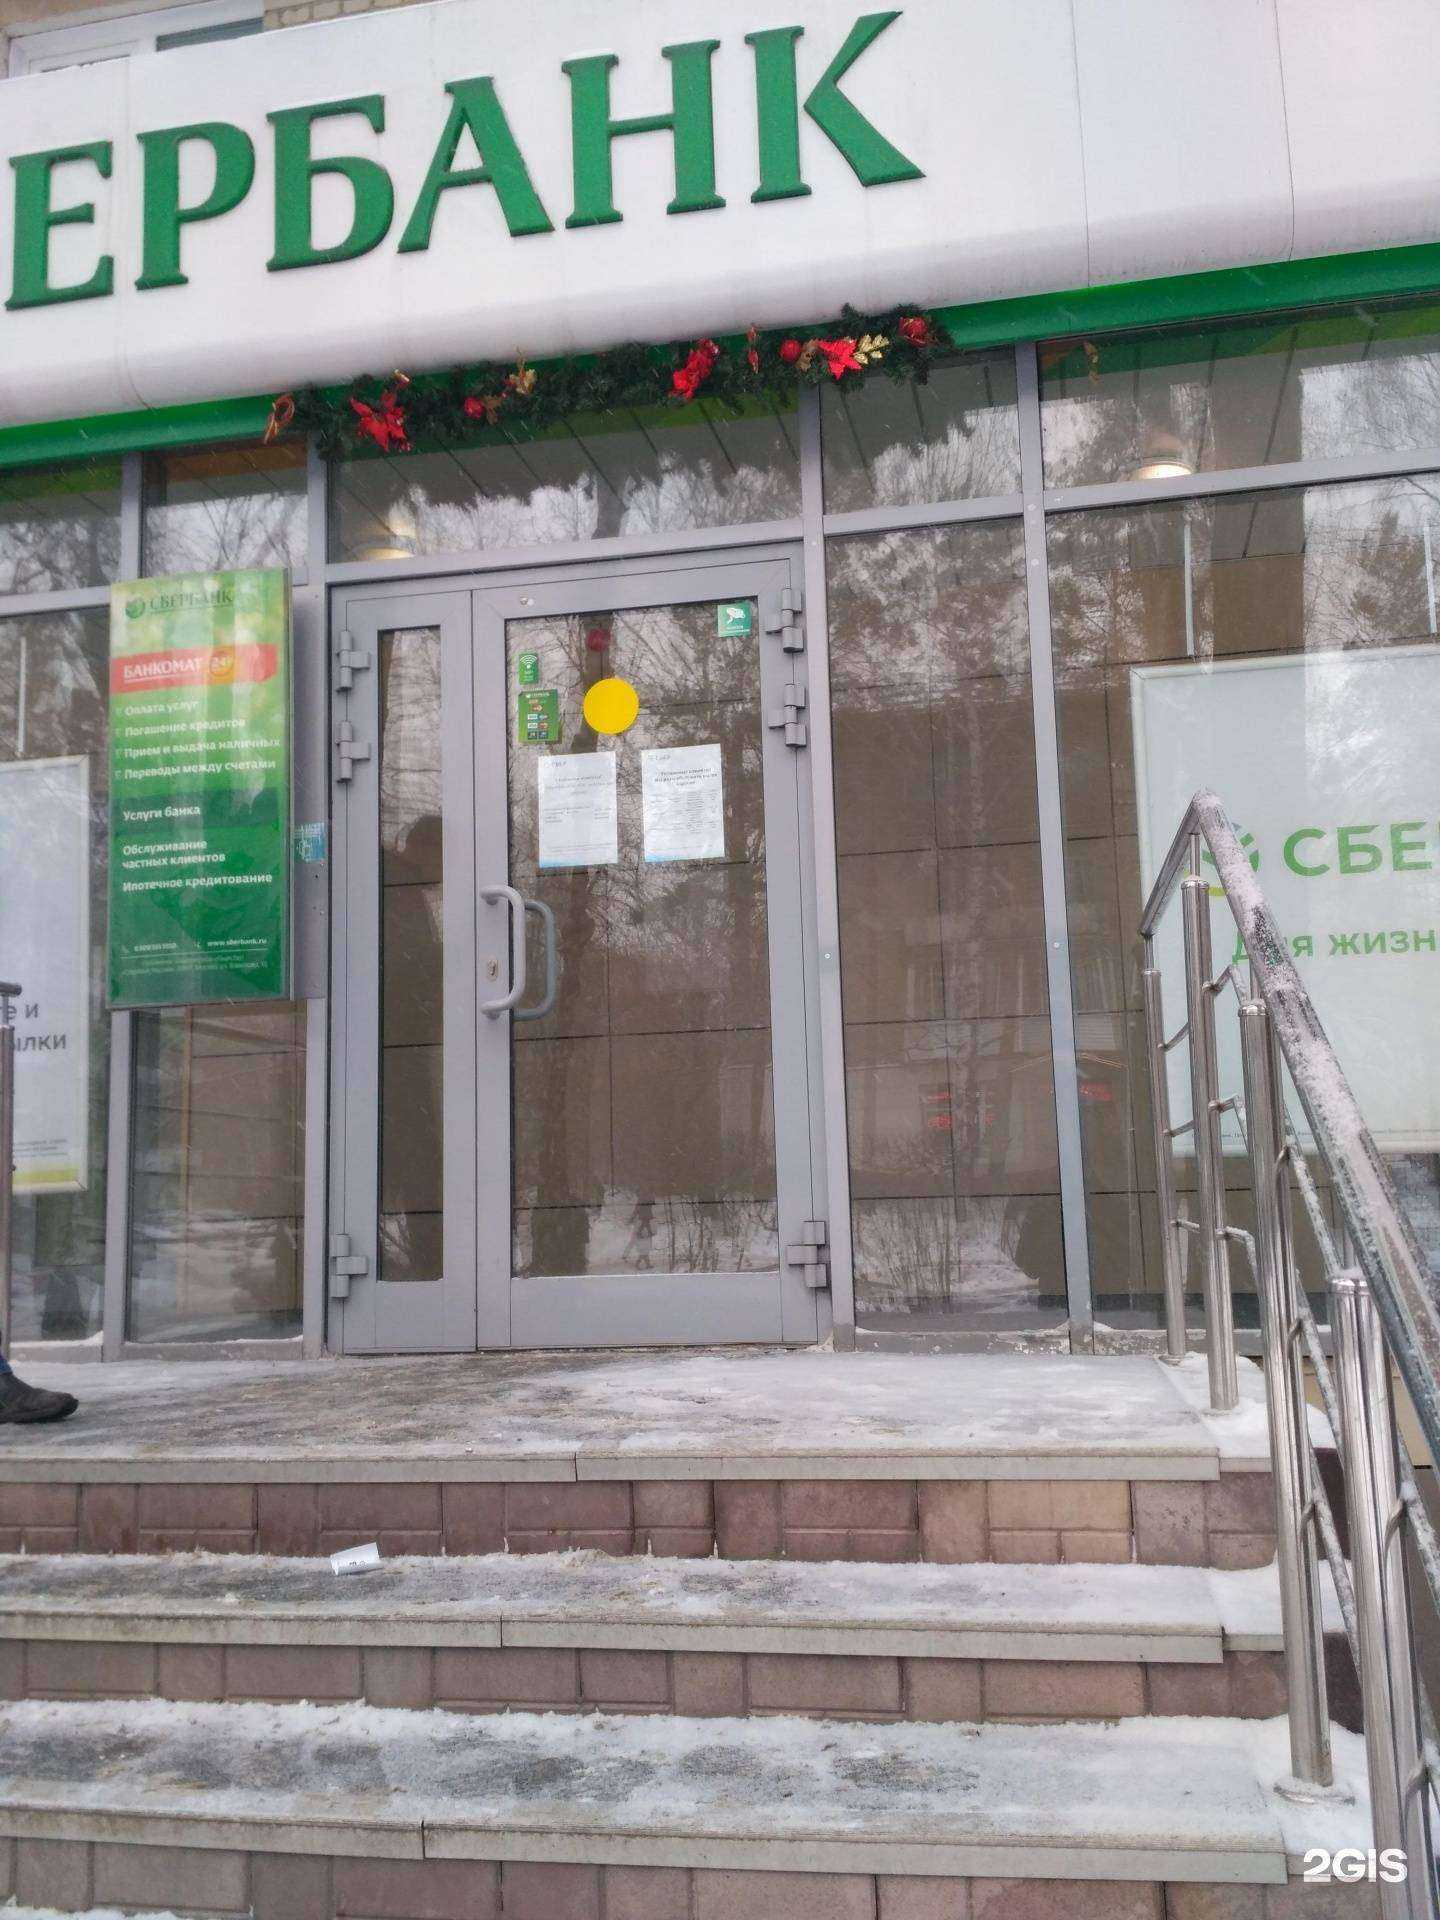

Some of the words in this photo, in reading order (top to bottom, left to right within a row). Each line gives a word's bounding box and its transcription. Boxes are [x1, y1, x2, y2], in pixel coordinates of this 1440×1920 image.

[5, 10, 926, 310] ЕРБАНК
[123, 657, 203, 679] БАНКОМАТ
[124, 704, 166, 716] Оплата
[168, 701, 200, 713] услуг
[125, 723, 187, 737] Погашение
[189, 719, 246, 733] кредитов
[163, 745, 171, 754] и
[173, 742, 216, 754] выдача
[219, 738, 280, 750] наличных
[125, 764, 180, 780] Переводы
[182, 761, 222, 774] между
[224, 759, 276, 771] счетами
[123, 809, 162, 822] Услуги
[165, 806, 201, 817] банка
[123, 840, 208, 857] Обслуживание
[1283, 818, 1440, 877] СБЕ
[122, 857, 168, 869] частных
[170, 852, 226, 865] клиентов
[122, 878, 183, 893] Ипотечное
[185, 873, 273, 888] кредитование
[25, 1003, 39, 1019] и
